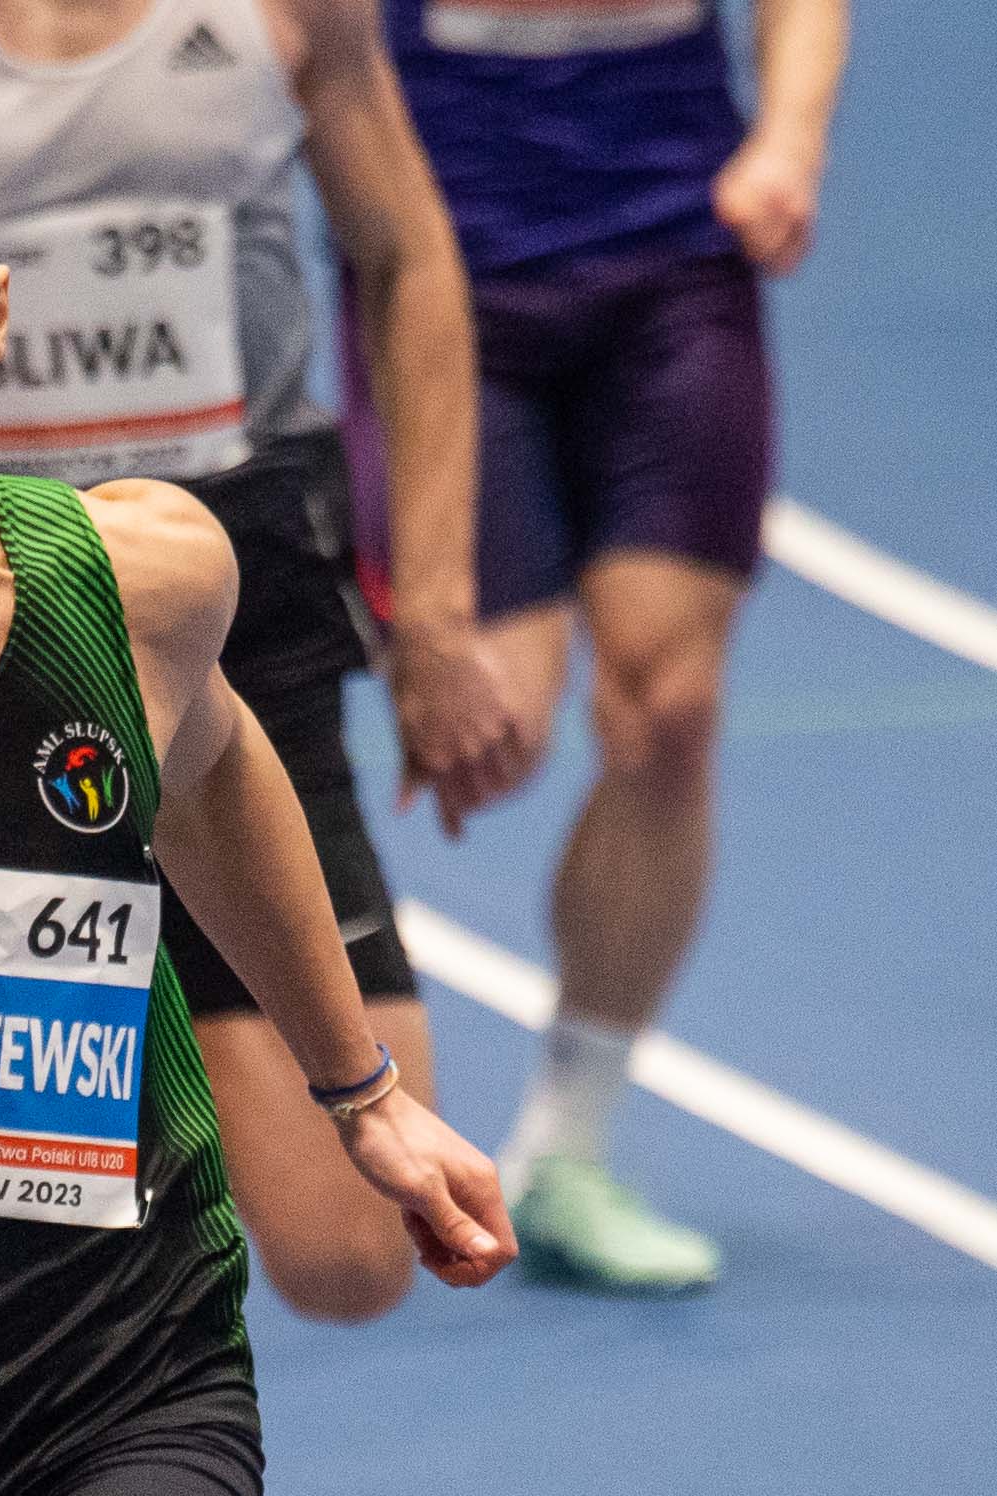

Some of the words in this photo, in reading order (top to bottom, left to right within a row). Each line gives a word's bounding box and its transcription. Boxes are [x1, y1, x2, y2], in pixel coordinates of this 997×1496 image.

[93, 217, 204, 277] 398
[27, 896, 134, 966] 641
[31, 1146, 76, 1166] Polski
[78, 1151, 100, 1168] U18
[101, 1152, 125, 1170] U20
[17, 1179, 83, 1207] 2023
